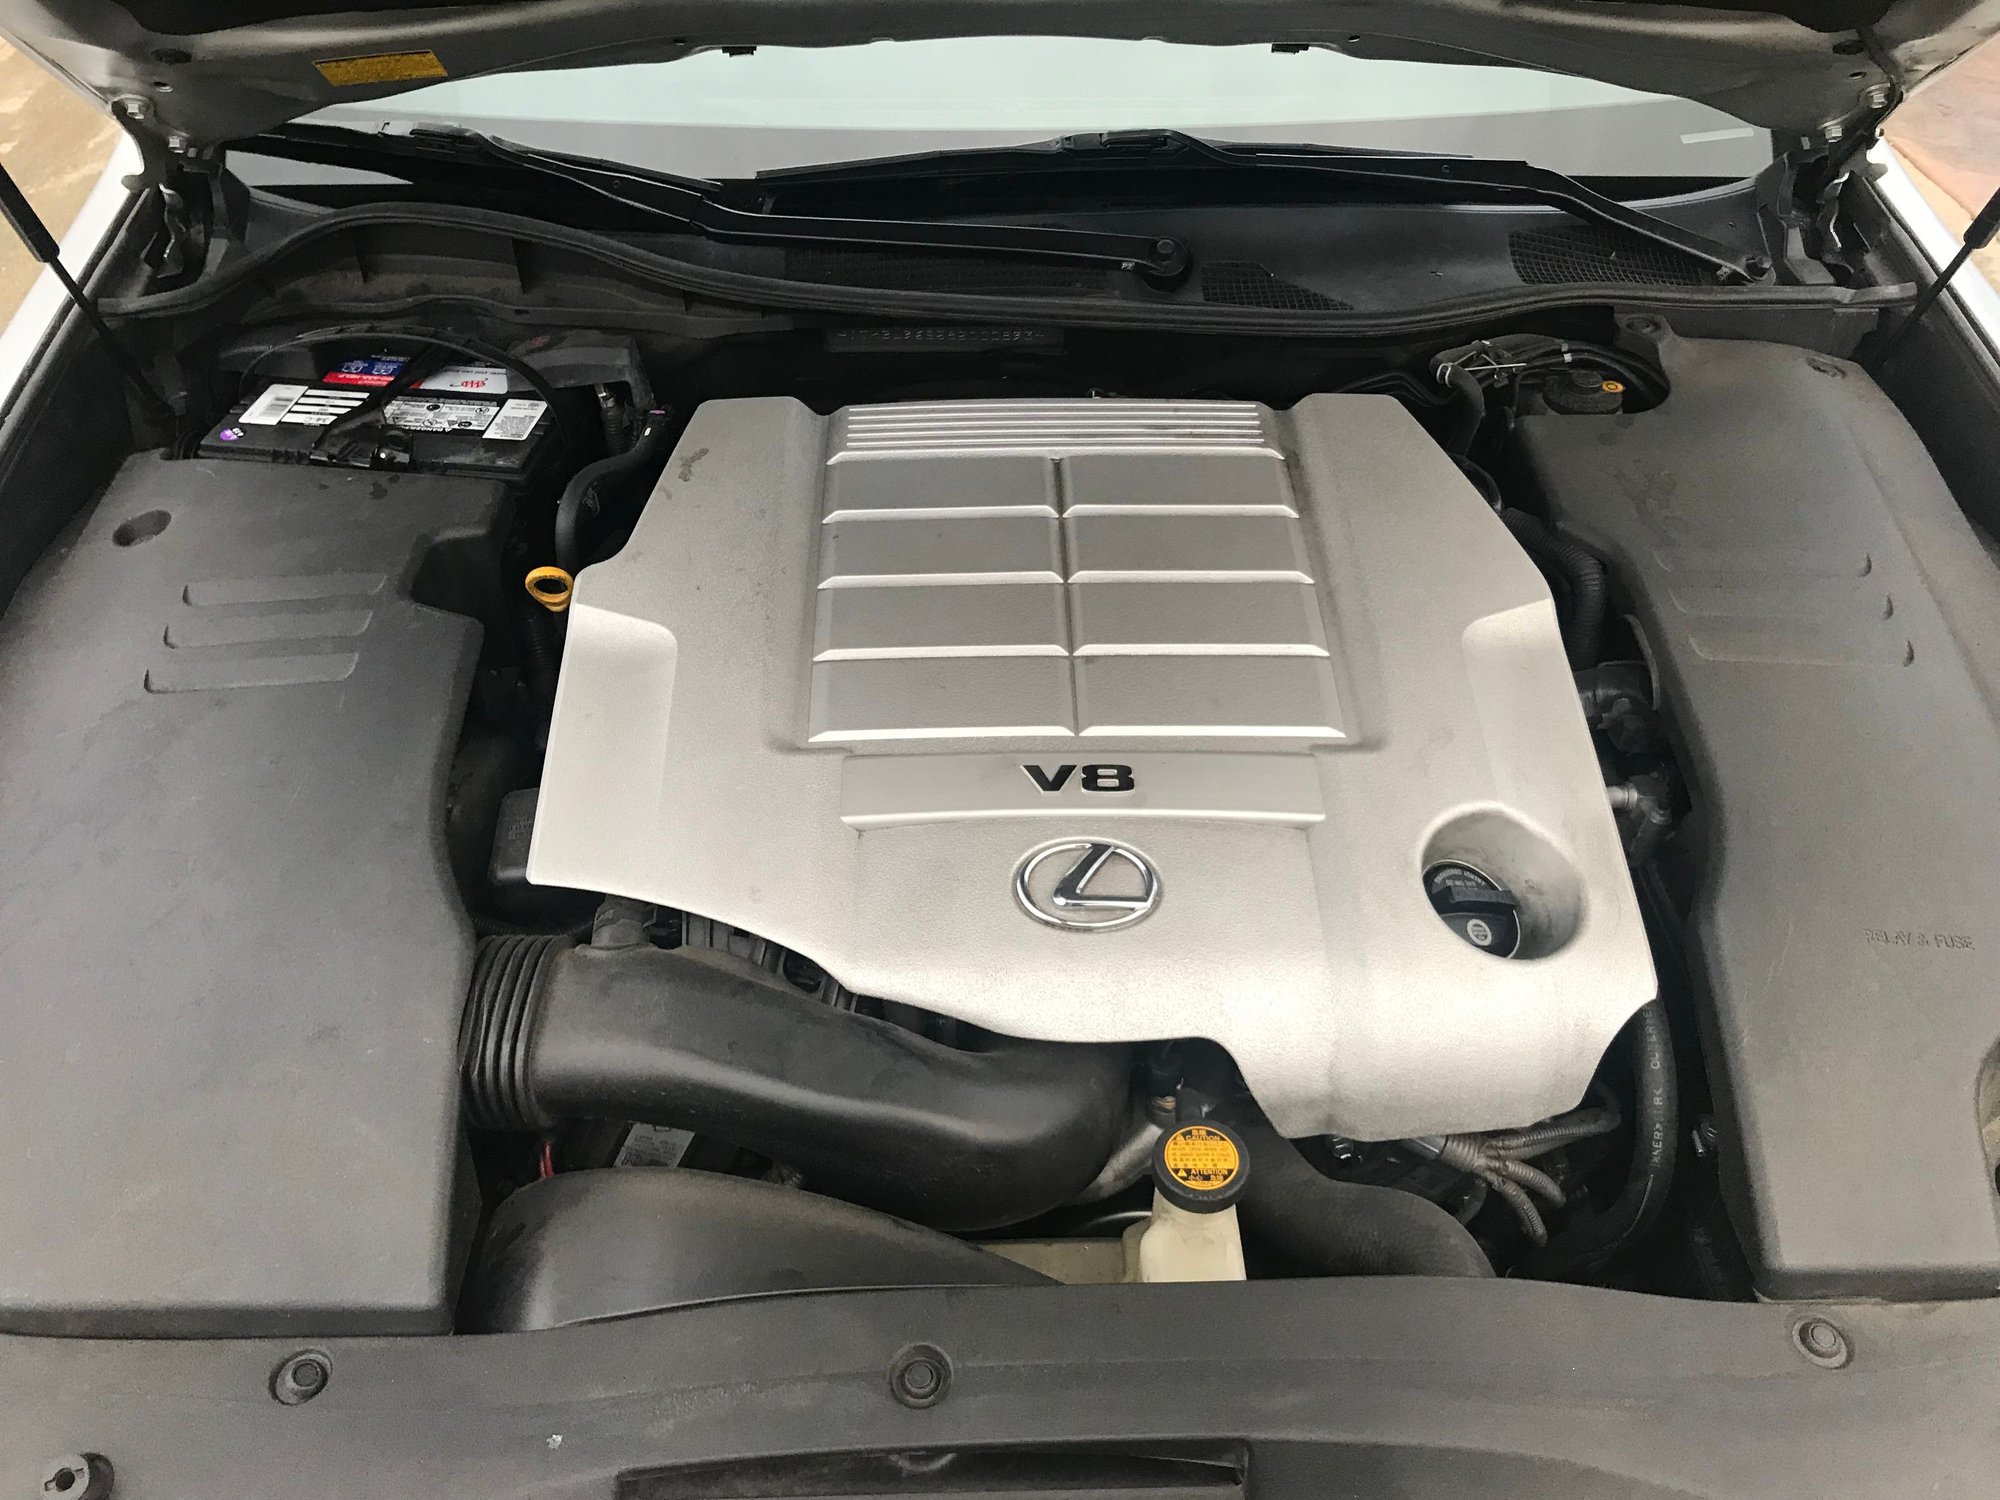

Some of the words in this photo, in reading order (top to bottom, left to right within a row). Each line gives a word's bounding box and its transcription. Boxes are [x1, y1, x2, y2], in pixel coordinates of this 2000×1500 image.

[1020, 764, 1135, 795] V8
[1863, 928, 1911, 945] RELAY
[1934, 933, 1975, 950] FUSE
